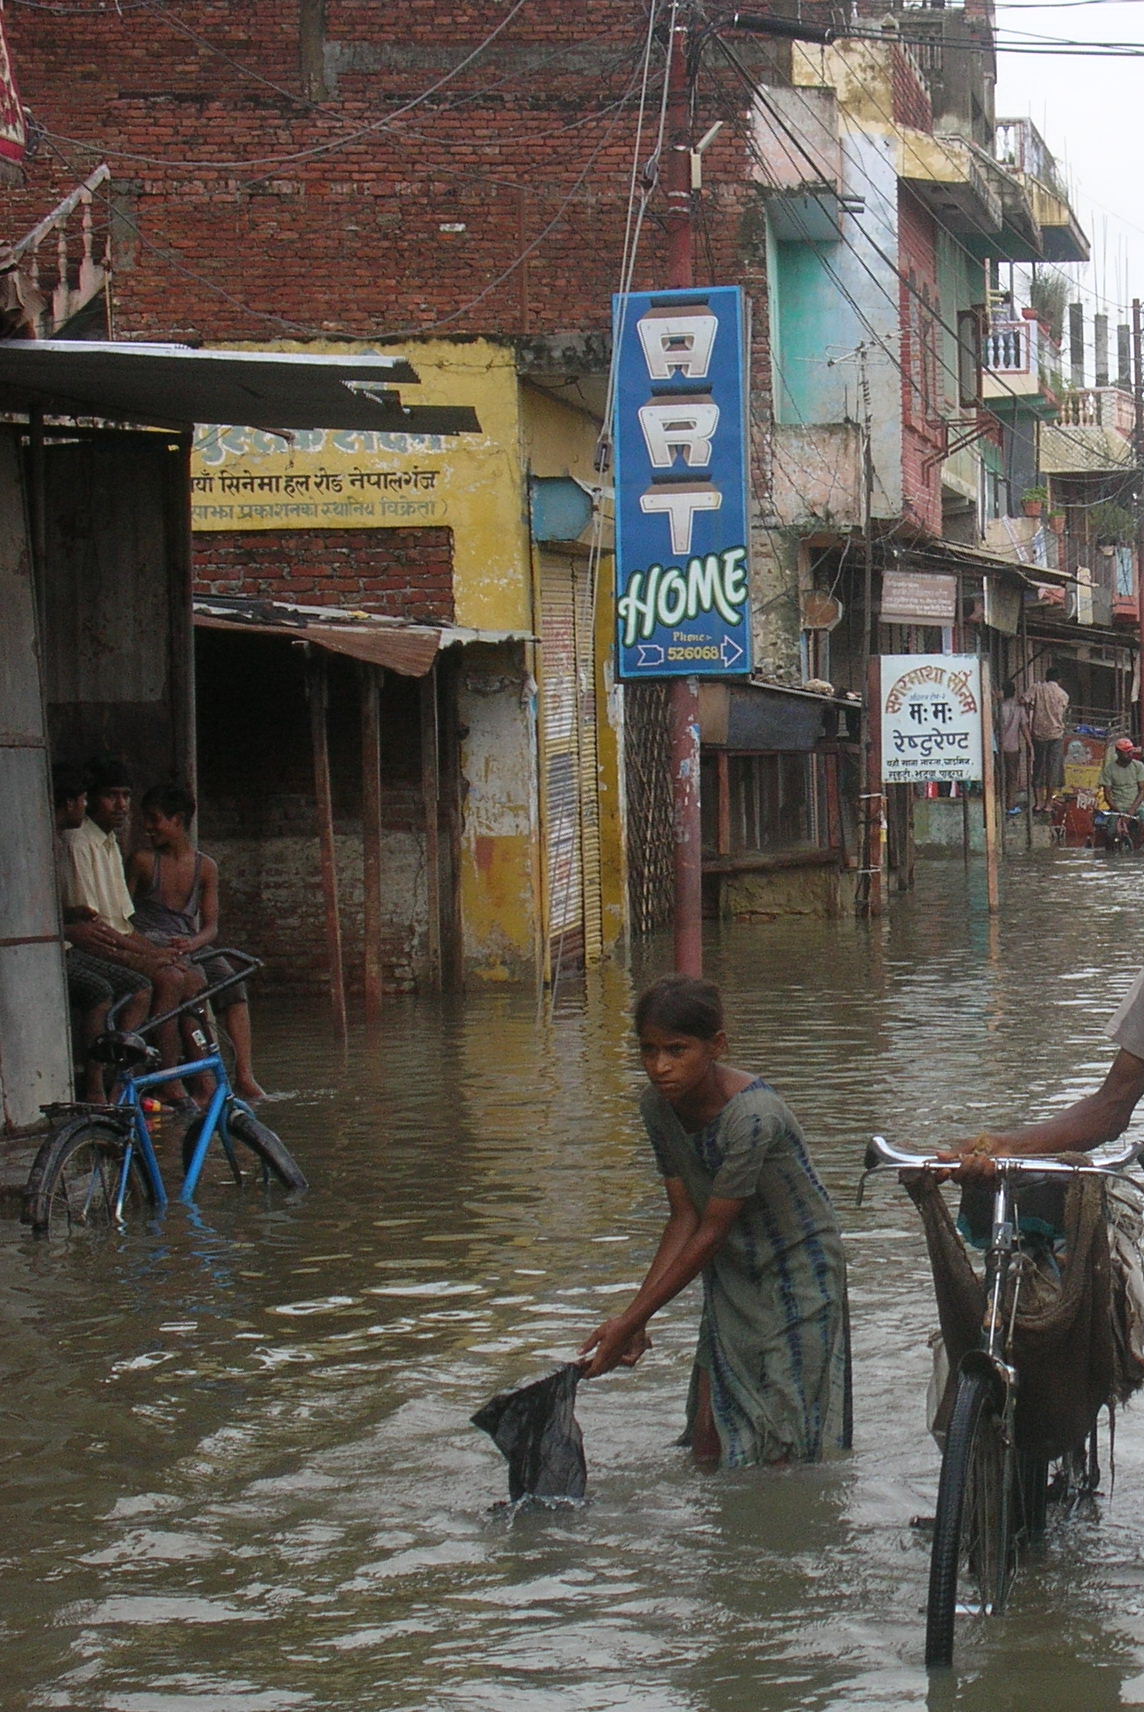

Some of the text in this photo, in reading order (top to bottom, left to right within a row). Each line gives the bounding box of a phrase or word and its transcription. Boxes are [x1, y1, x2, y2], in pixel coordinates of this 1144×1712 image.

[636, 302, 723, 556] ART
[219, 469, 282, 497] सिनेमा
[285, 474, 309, 498] हल
[314, 467, 343, 497] रोड
[349, 465, 440, 496] नेपालगंज
[618, 547, 748, 647] HOME
[667, 646, 719, 661] 526068
